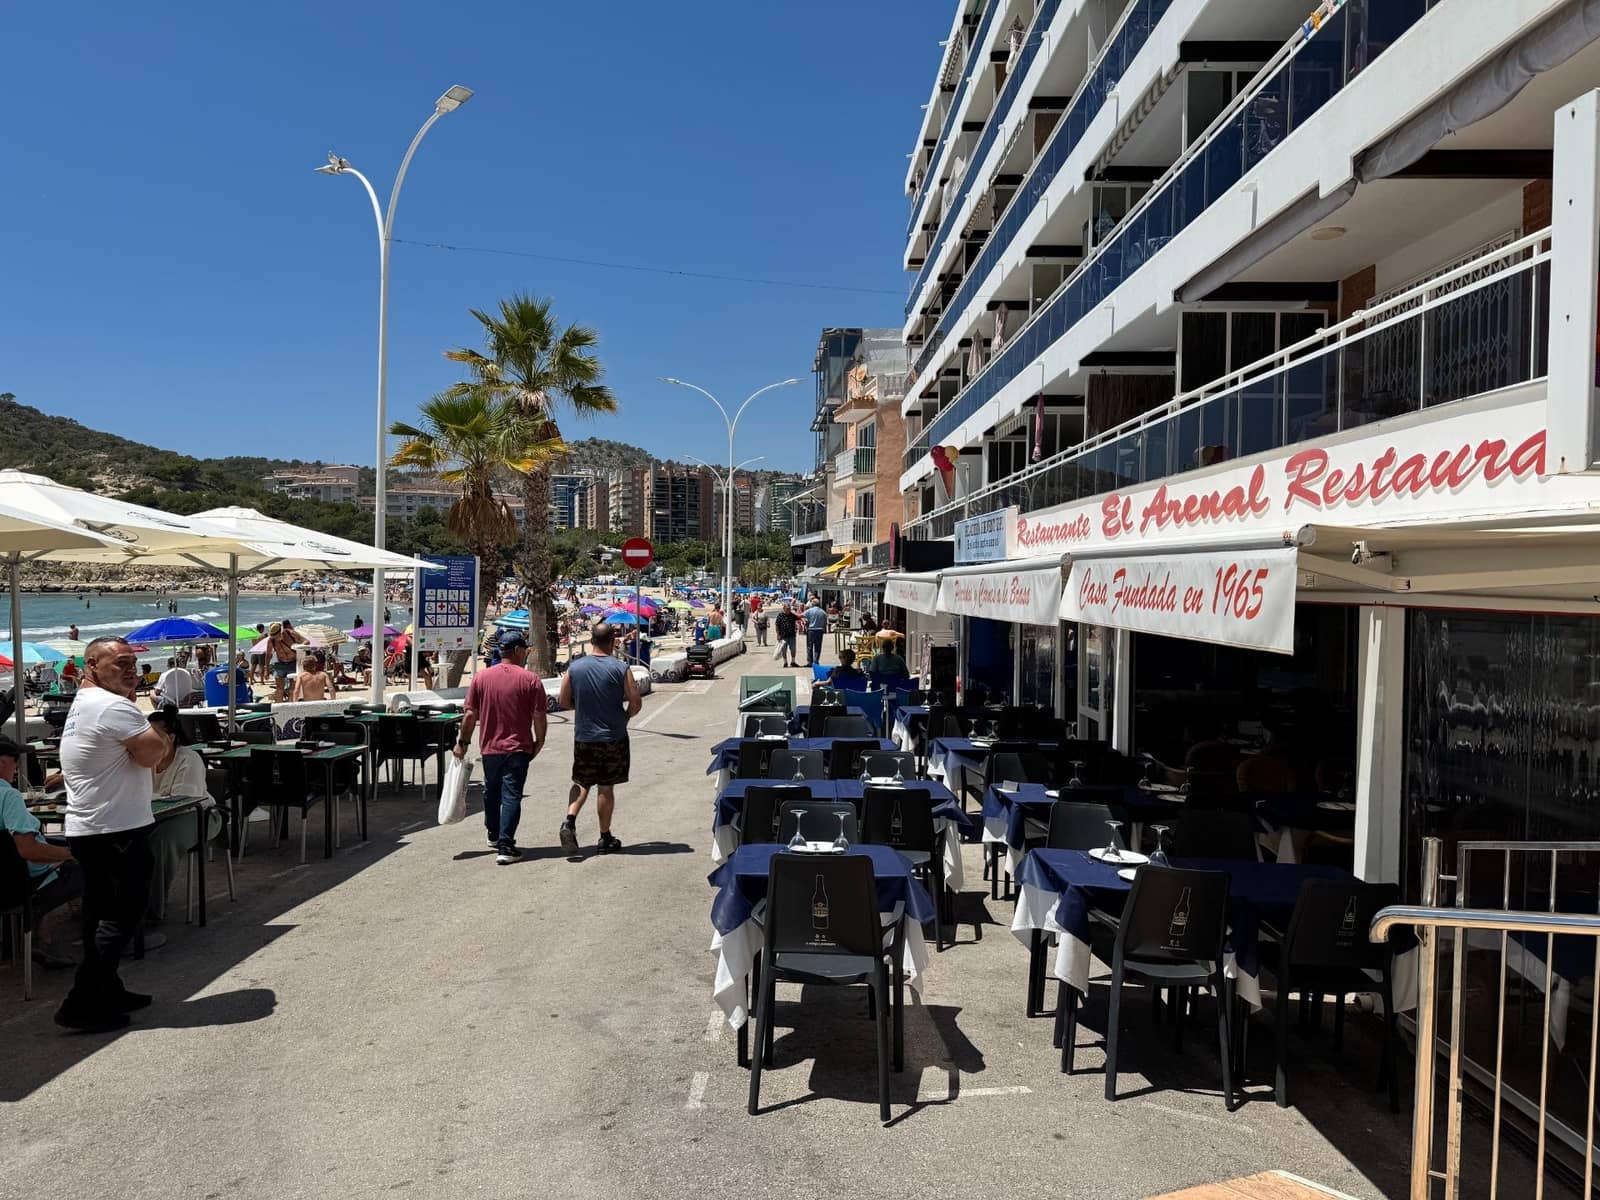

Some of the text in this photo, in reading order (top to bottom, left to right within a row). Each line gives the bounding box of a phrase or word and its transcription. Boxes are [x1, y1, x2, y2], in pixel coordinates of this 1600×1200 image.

[1017, 512, 1091, 546] Restaurante
[1102, 493, 1134, 537] El
[1139, 463, 1270, 534] Arenal
[1080, 562, 1269, 620] Casa Fundada en 1965
